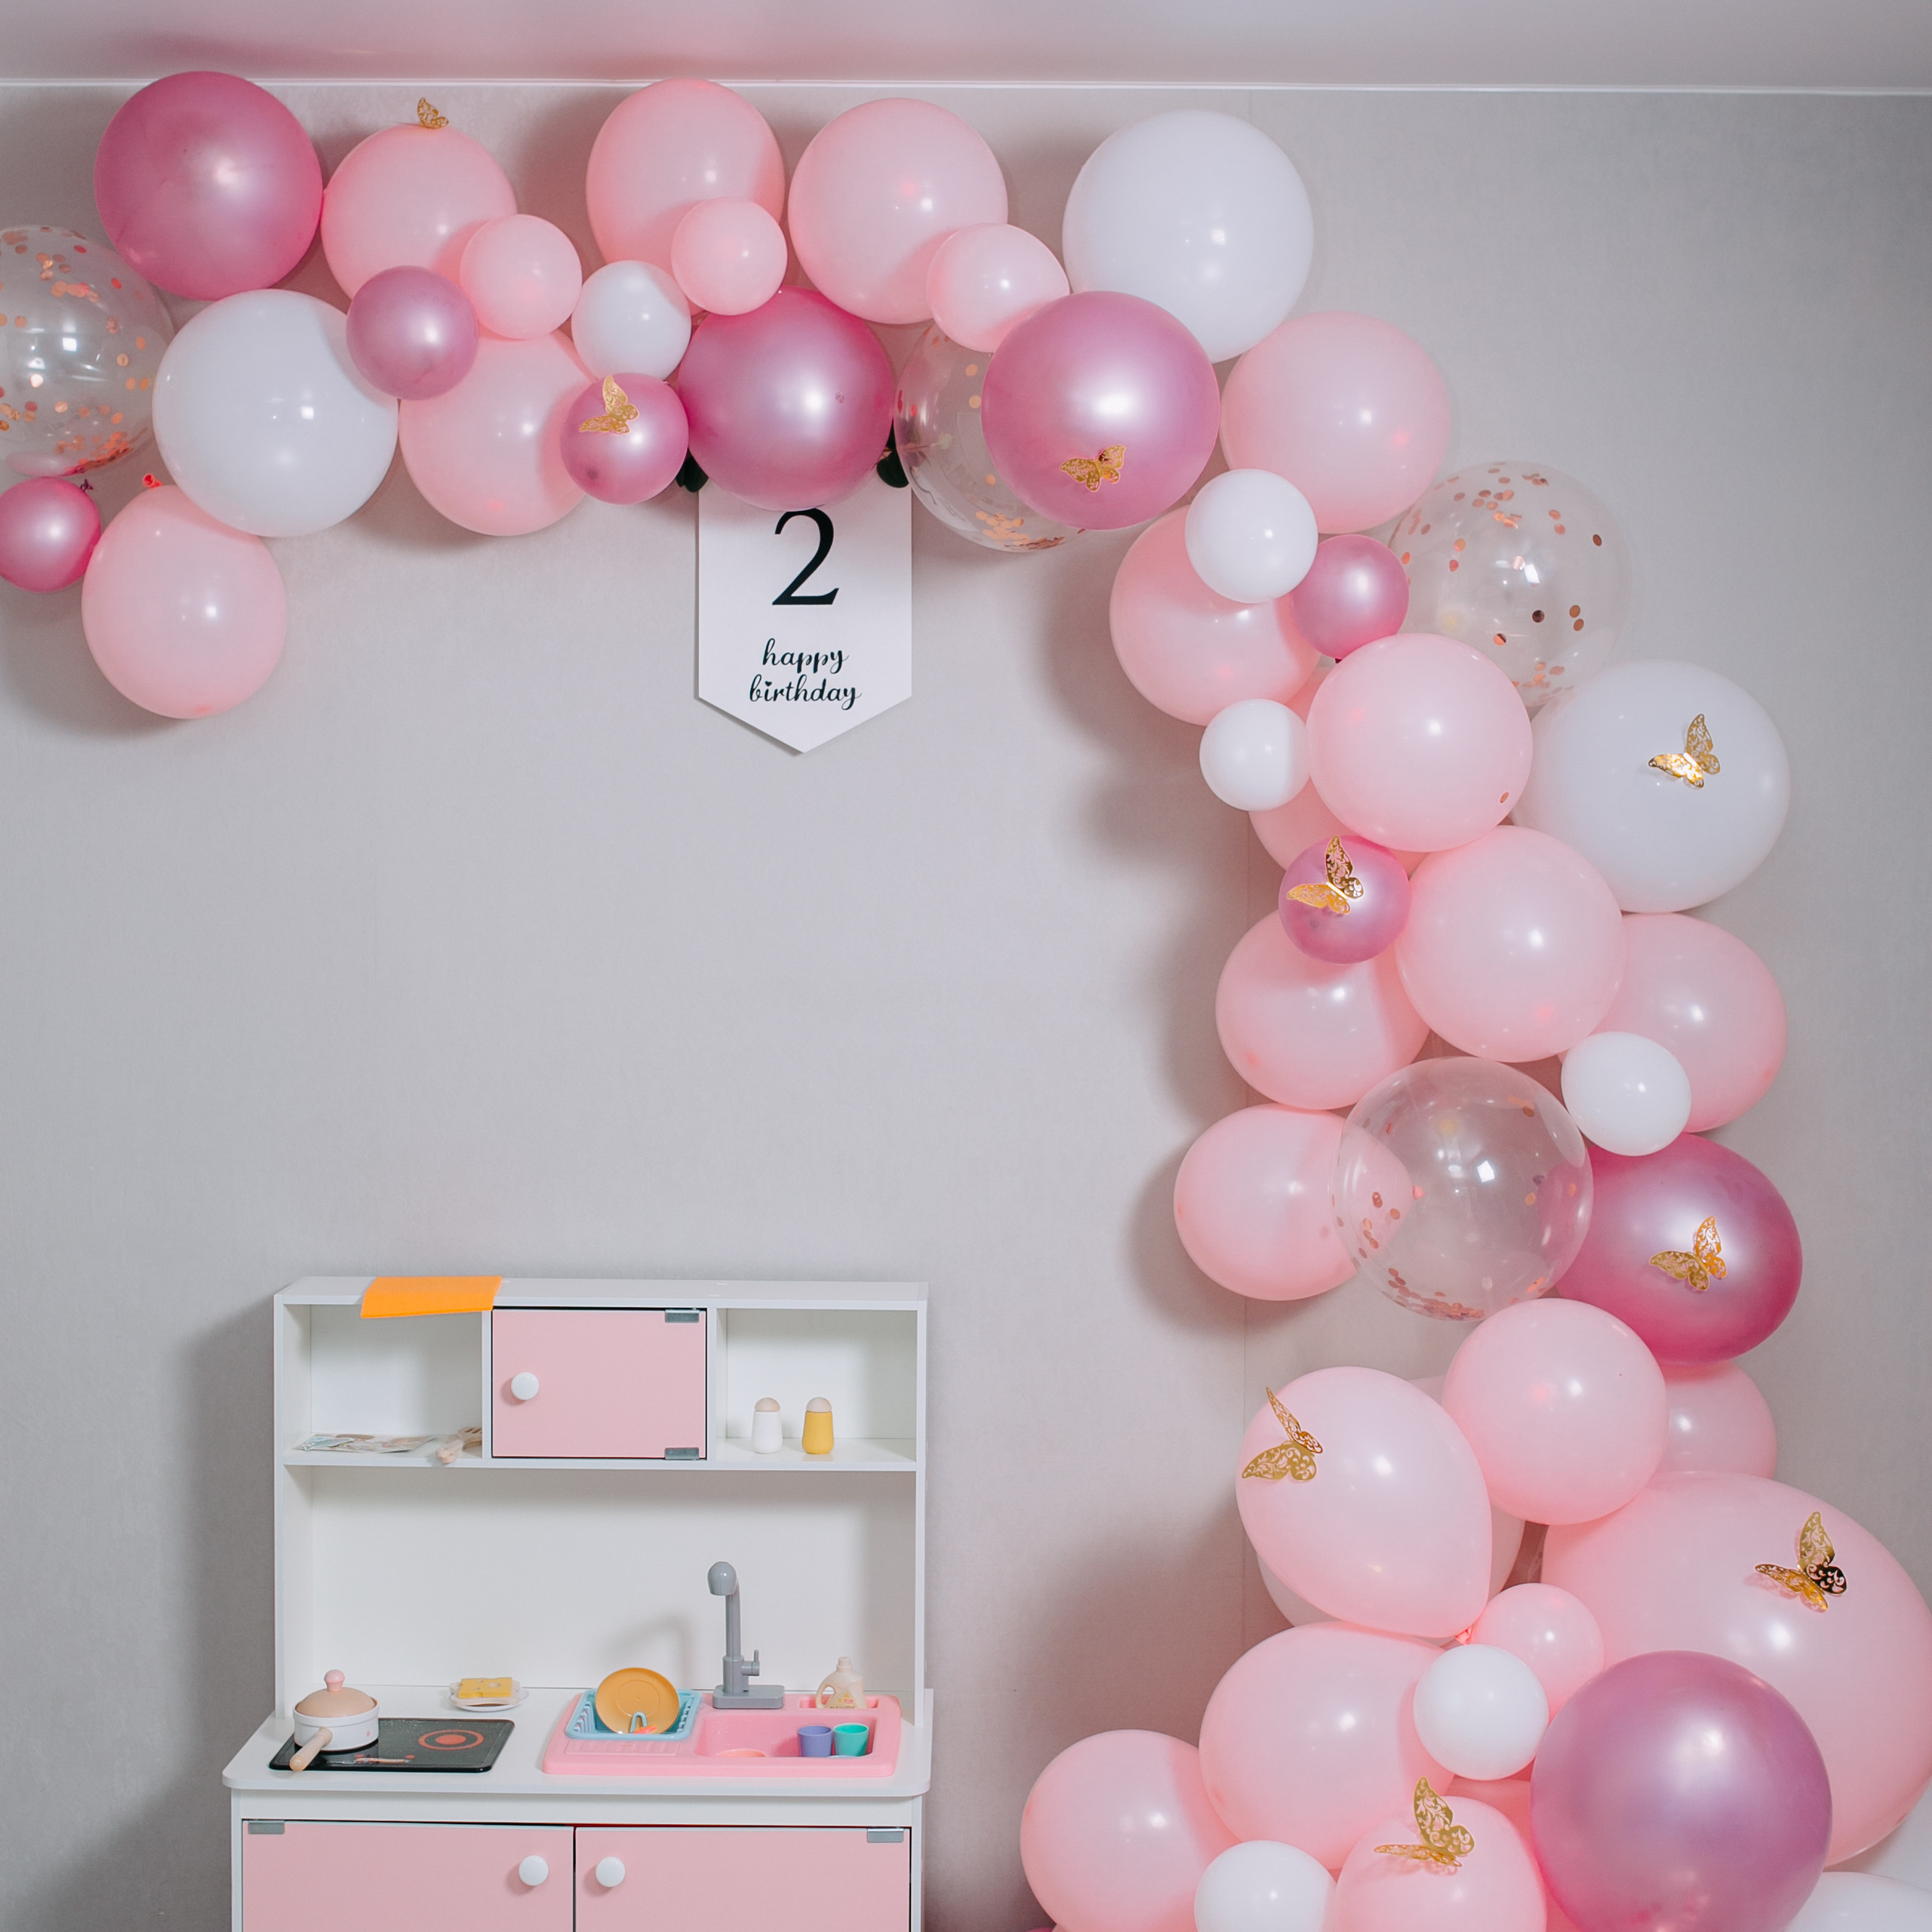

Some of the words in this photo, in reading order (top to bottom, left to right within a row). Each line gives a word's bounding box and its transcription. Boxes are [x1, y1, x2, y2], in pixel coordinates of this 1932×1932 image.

[772, 507, 839, 606] 2
[762, 638, 849, 674] happy
[749, 674, 862, 711] birthday
